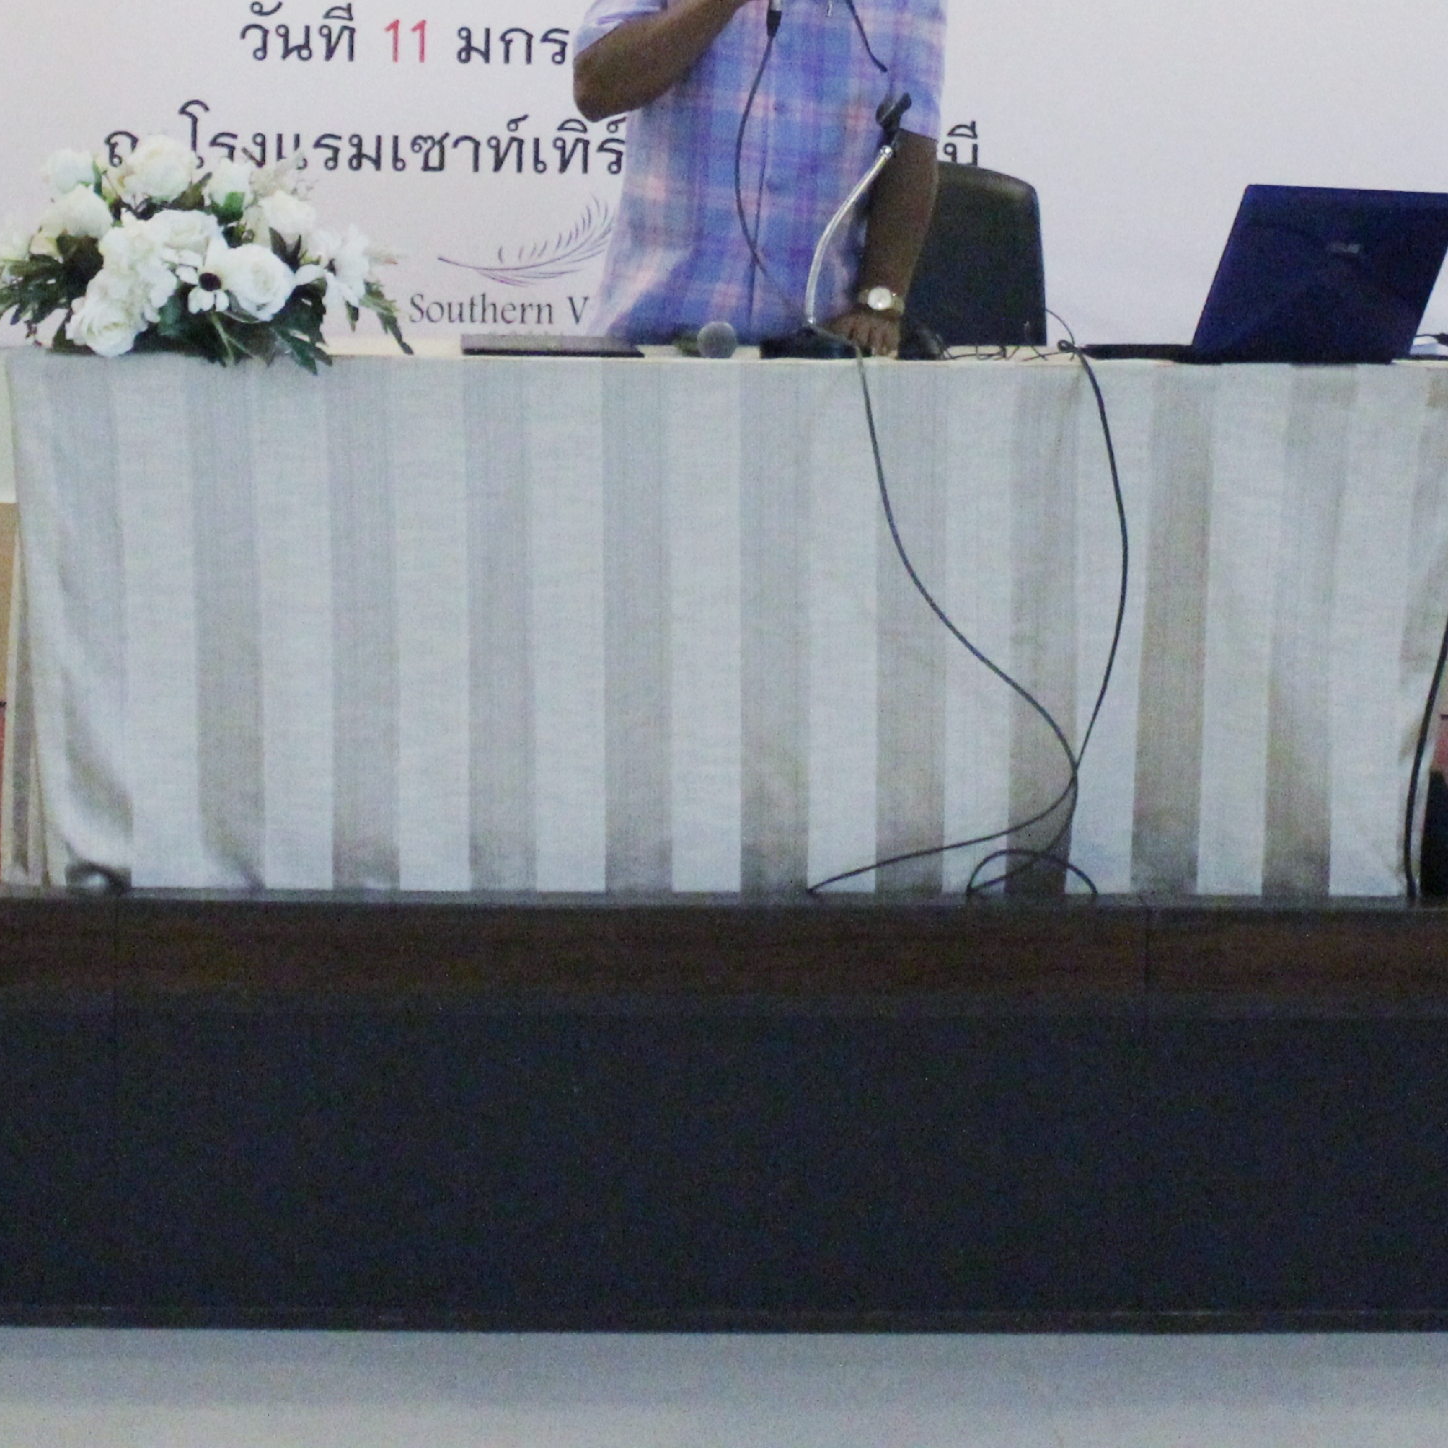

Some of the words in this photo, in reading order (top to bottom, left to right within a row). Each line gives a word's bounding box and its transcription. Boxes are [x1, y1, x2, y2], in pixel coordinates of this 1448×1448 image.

[384, 18, 428, 64] 11
[178, 99, 628, 176] โรงแรมเซาท์เทิร์
[408, 292, 555, 325] Southern
